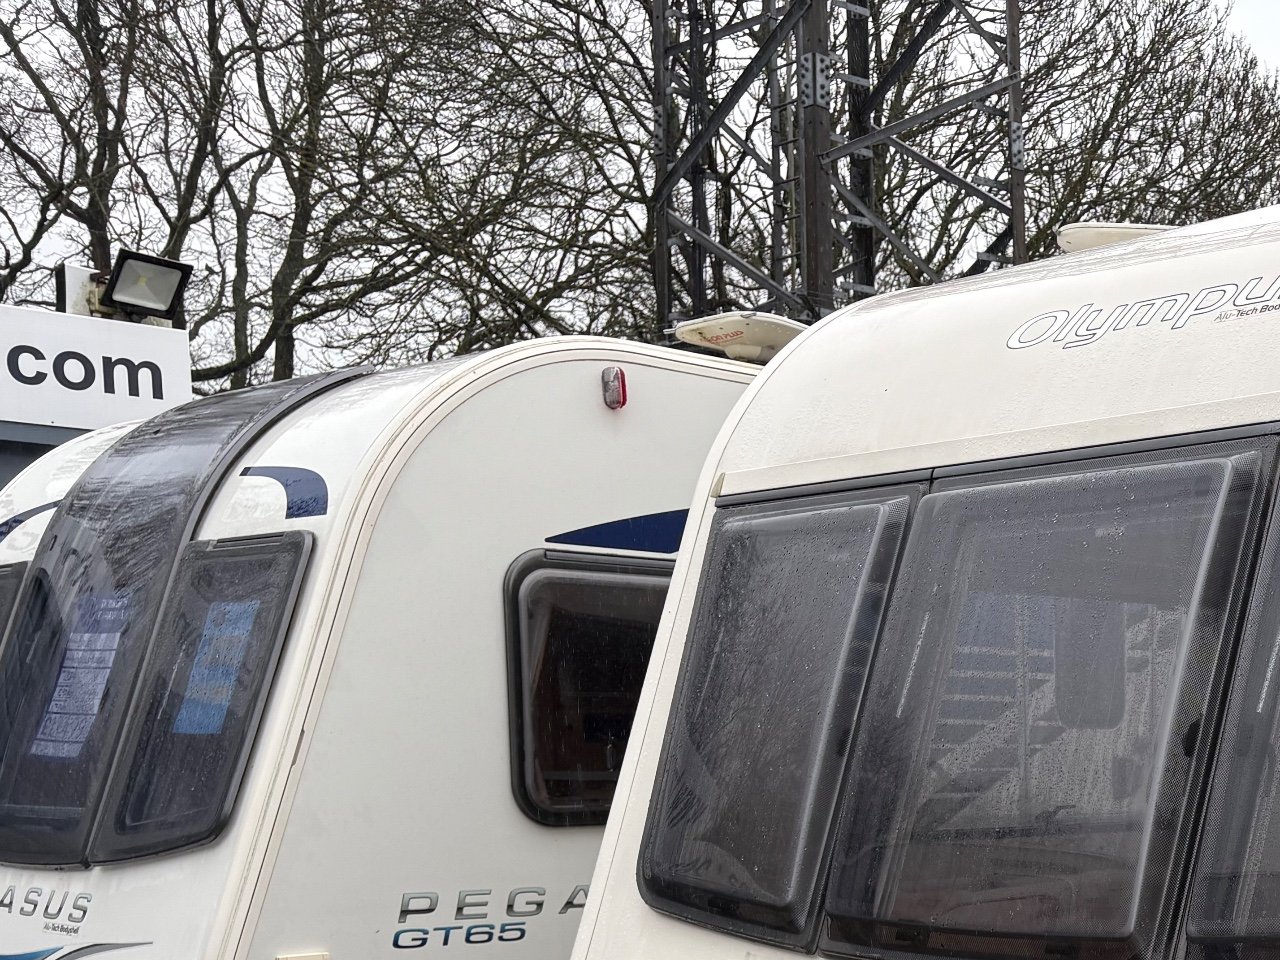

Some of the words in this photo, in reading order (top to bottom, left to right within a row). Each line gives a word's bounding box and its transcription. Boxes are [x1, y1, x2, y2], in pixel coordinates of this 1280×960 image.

[1214, 308, 1258, 322] Alu-Tech
[7, 345, 163, 400] com
[0, 885, 93, 923] ASUS
[398, 884, 591, 923] PEGA
[392, 921, 527, 949] GT65
